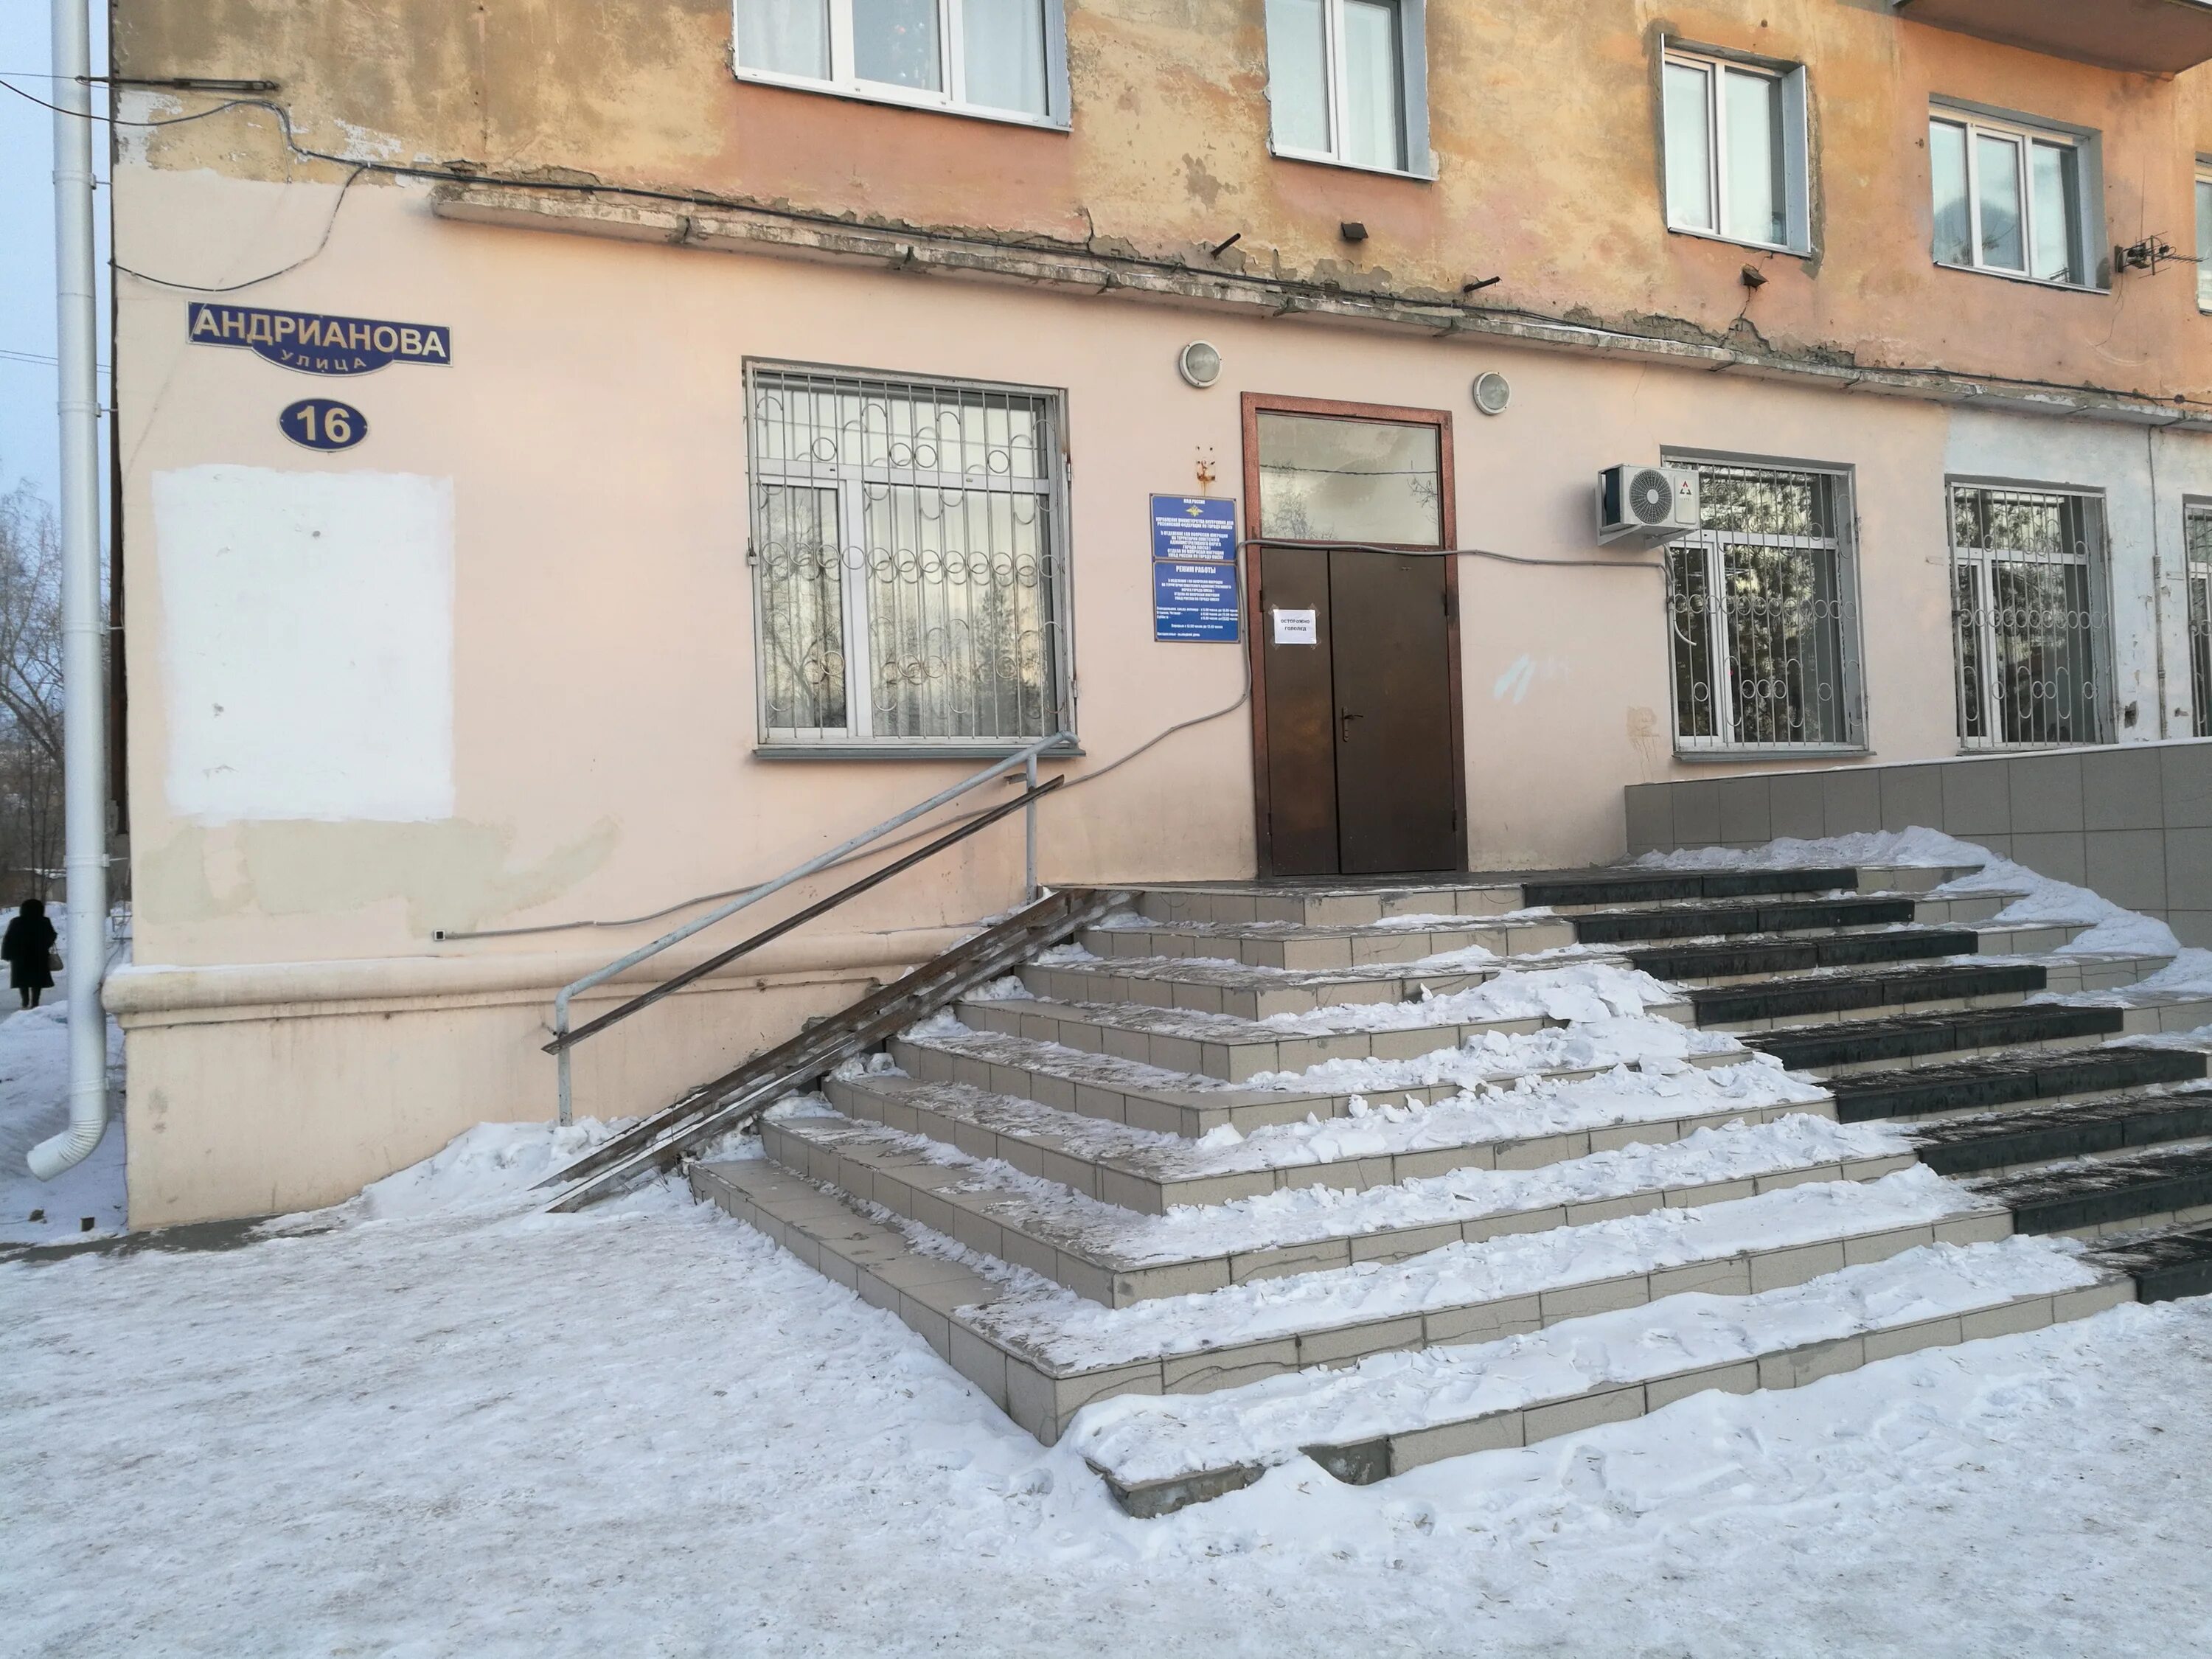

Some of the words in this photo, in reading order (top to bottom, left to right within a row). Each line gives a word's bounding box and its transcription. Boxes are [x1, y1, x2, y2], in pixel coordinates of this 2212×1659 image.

[193, 308, 447, 358] АНДРИАНОВА
[281, 349, 367, 372] УЛИЦА
[297, 405, 352, 443] 16
[1195, 566, 1216, 574] РАБОТЫ
